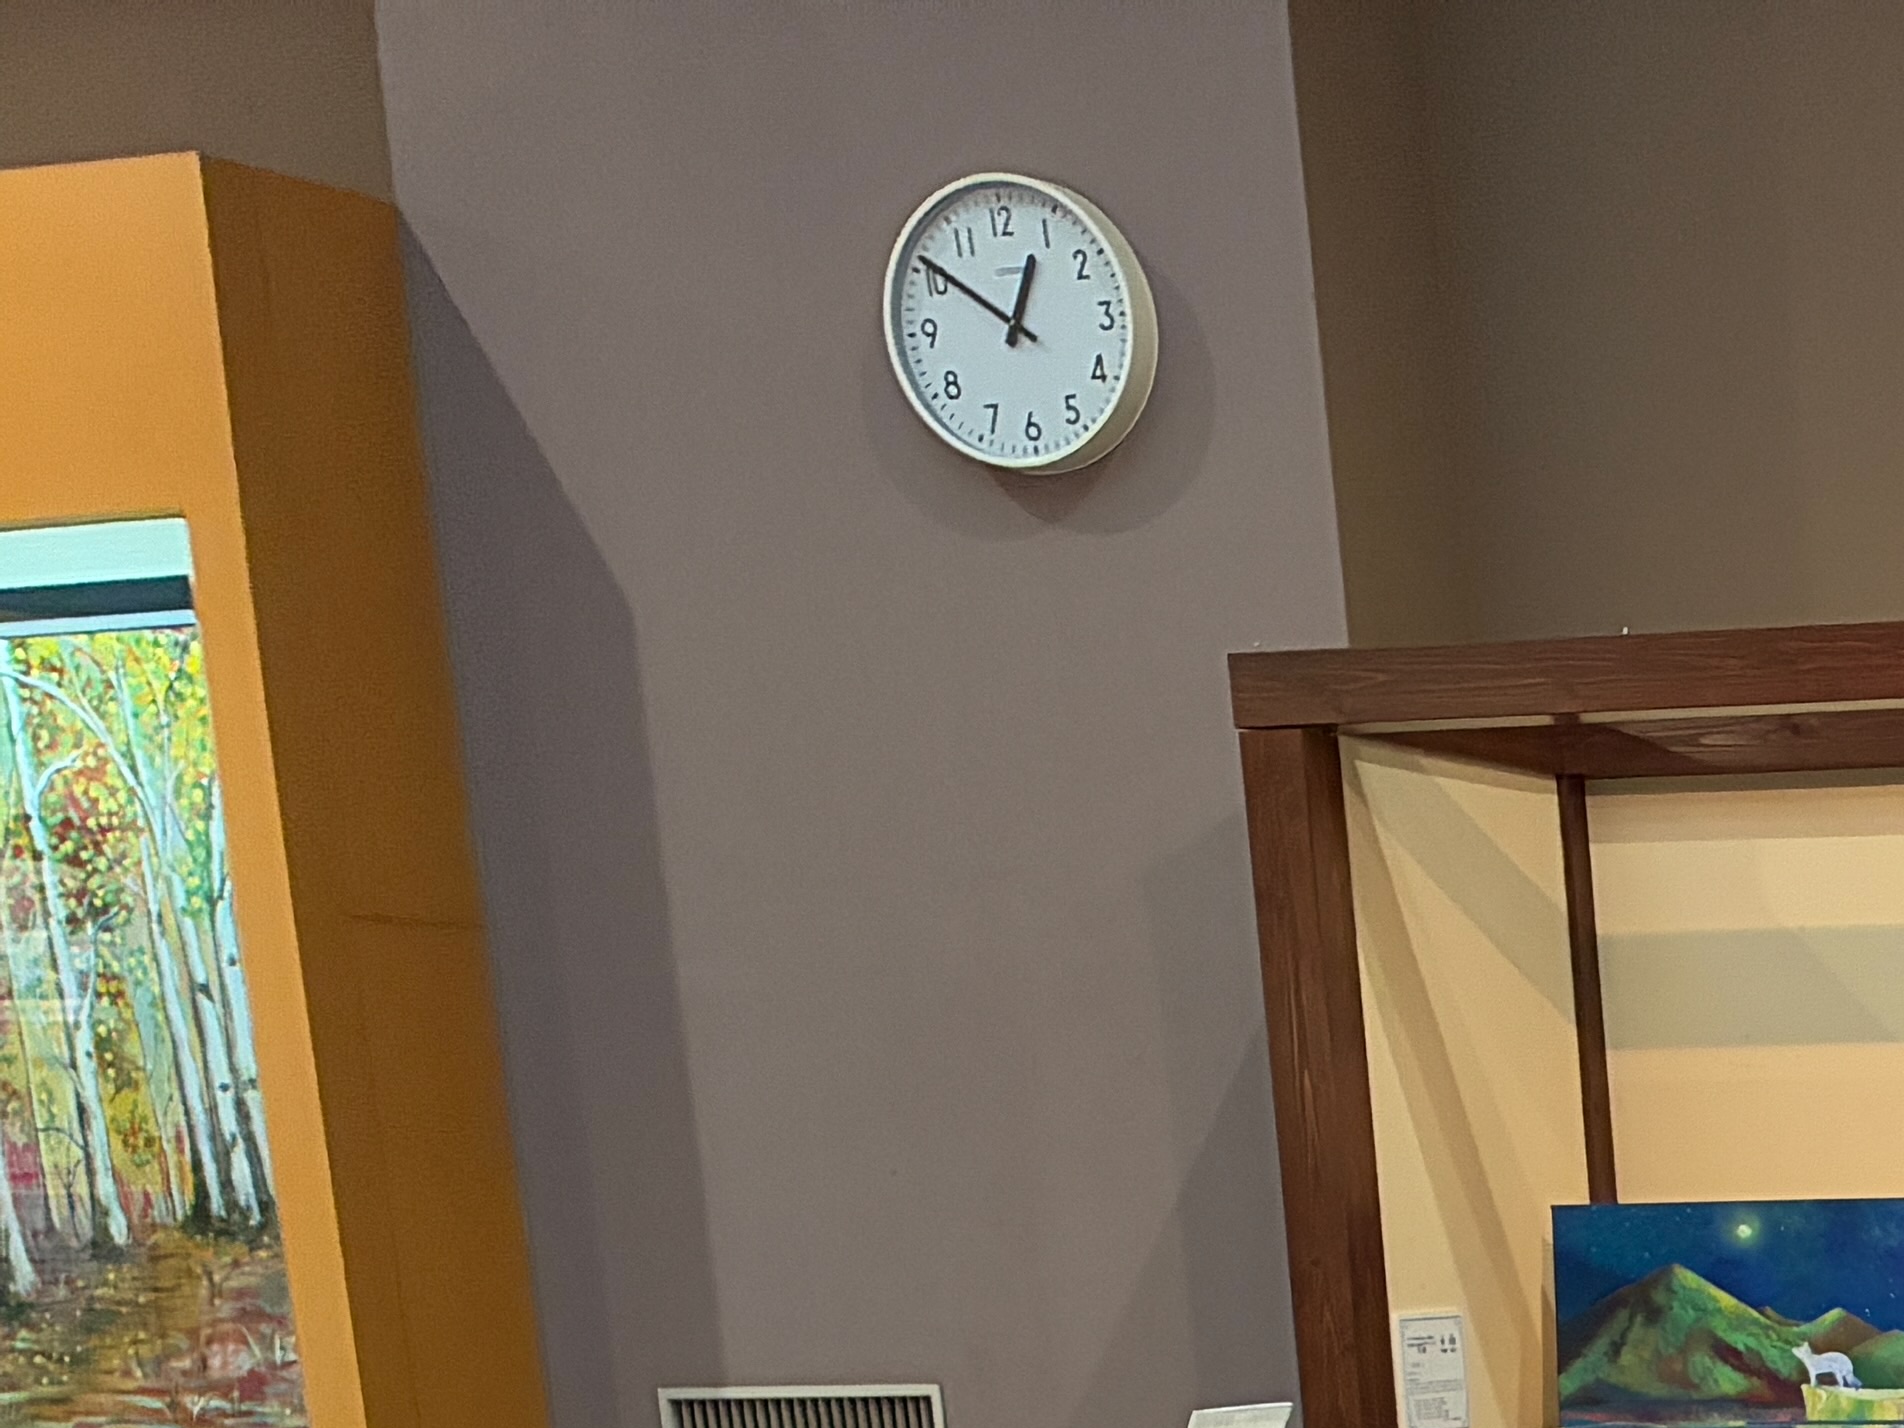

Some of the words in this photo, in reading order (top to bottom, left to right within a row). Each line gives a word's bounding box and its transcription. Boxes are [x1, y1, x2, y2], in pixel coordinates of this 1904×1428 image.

[990, 206, 1014, 237] 12
[1042, 219, 1051, 248] 1
[953, 227, 975, 257] 11
[1073, 249, 1091, 280] 2
[925, 265, 948, 297] 10
[1098, 301, 1114, 331] 3
[921, 318, 937, 348] 9
[1092, 354, 1107, 382] 4
[944, 371, 961, 399] 8
[984, 404, 999, 434] 7
[1065, 394, 1081, 425] 5
[1025, 411, 1042, 441] 6
